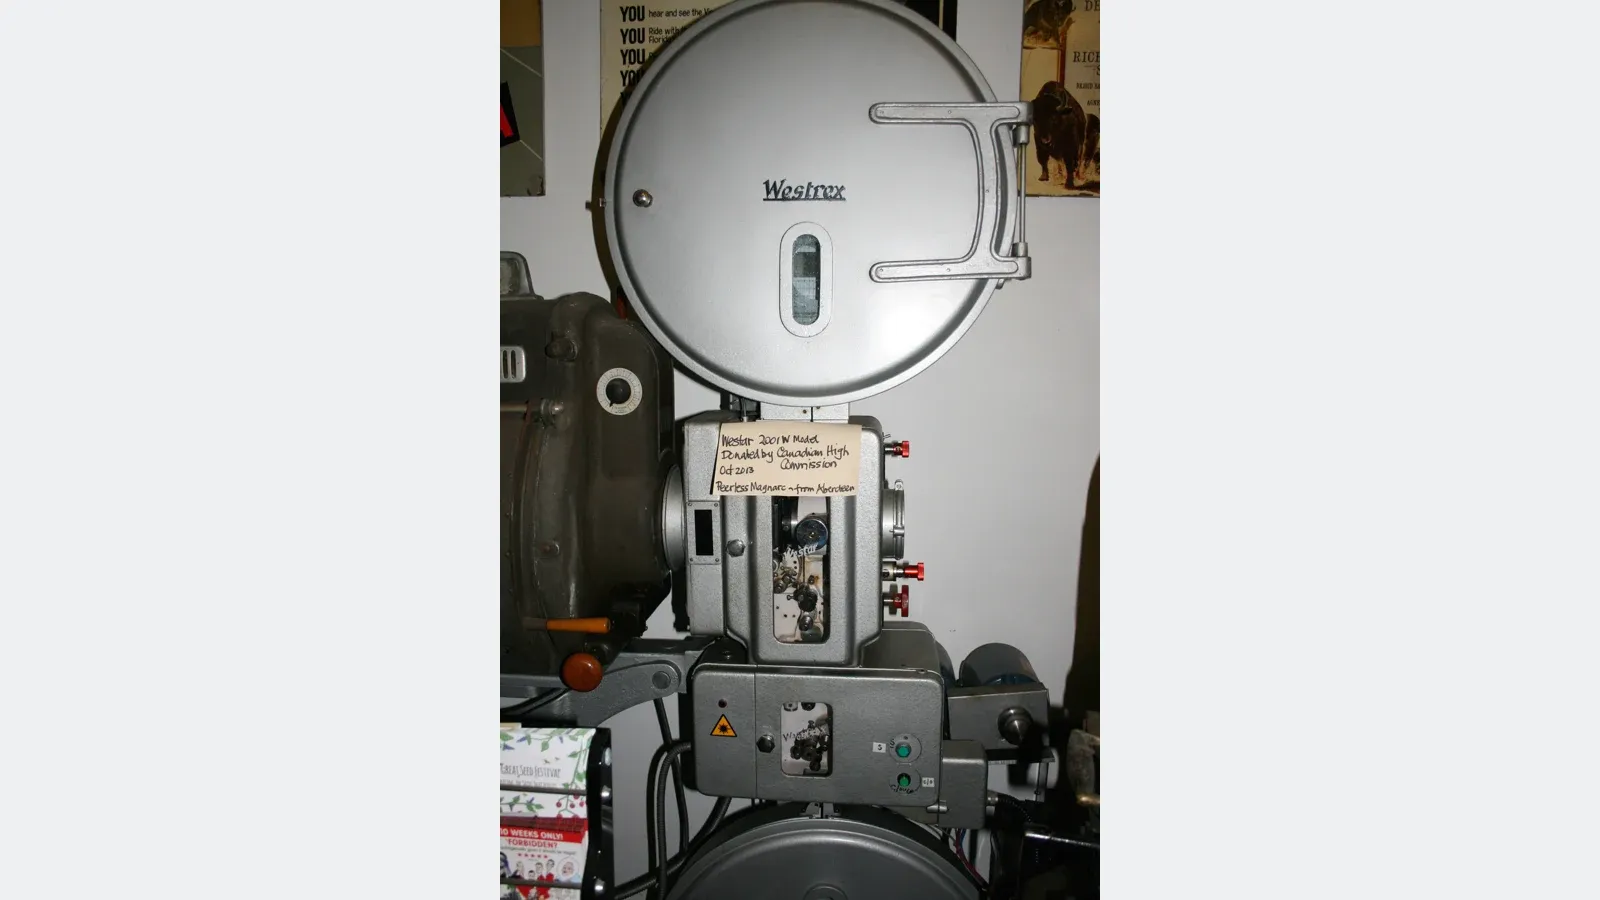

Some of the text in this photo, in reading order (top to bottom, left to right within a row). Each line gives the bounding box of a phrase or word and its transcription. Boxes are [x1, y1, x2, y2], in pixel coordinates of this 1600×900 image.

[620, 6, 645, 22] YOU
[692, 8, 702, 16] the
[620, 28, 645, 44] YOU
[665, 27, 680, 35] with
[620, 49, 645, 65] YOU
[763, 179, 846, 201] Westrex
[722, 434, 754, 446] Westar
[793, 434, 820, 444] Model
[721, 443, 850, 463] Donated by Canadian High
[719, 465, 755, 475] Oct 2013
[780, 458, 838, 470] Commission
[716, 480, 749, 493] Peerless
[750, 481, 787, 495] Magnarc
[816, 483, 855, 495] Aberdeen
[510, 829, 539, 838] WEEKS
[540, 831, 563, 841] ONLY!
